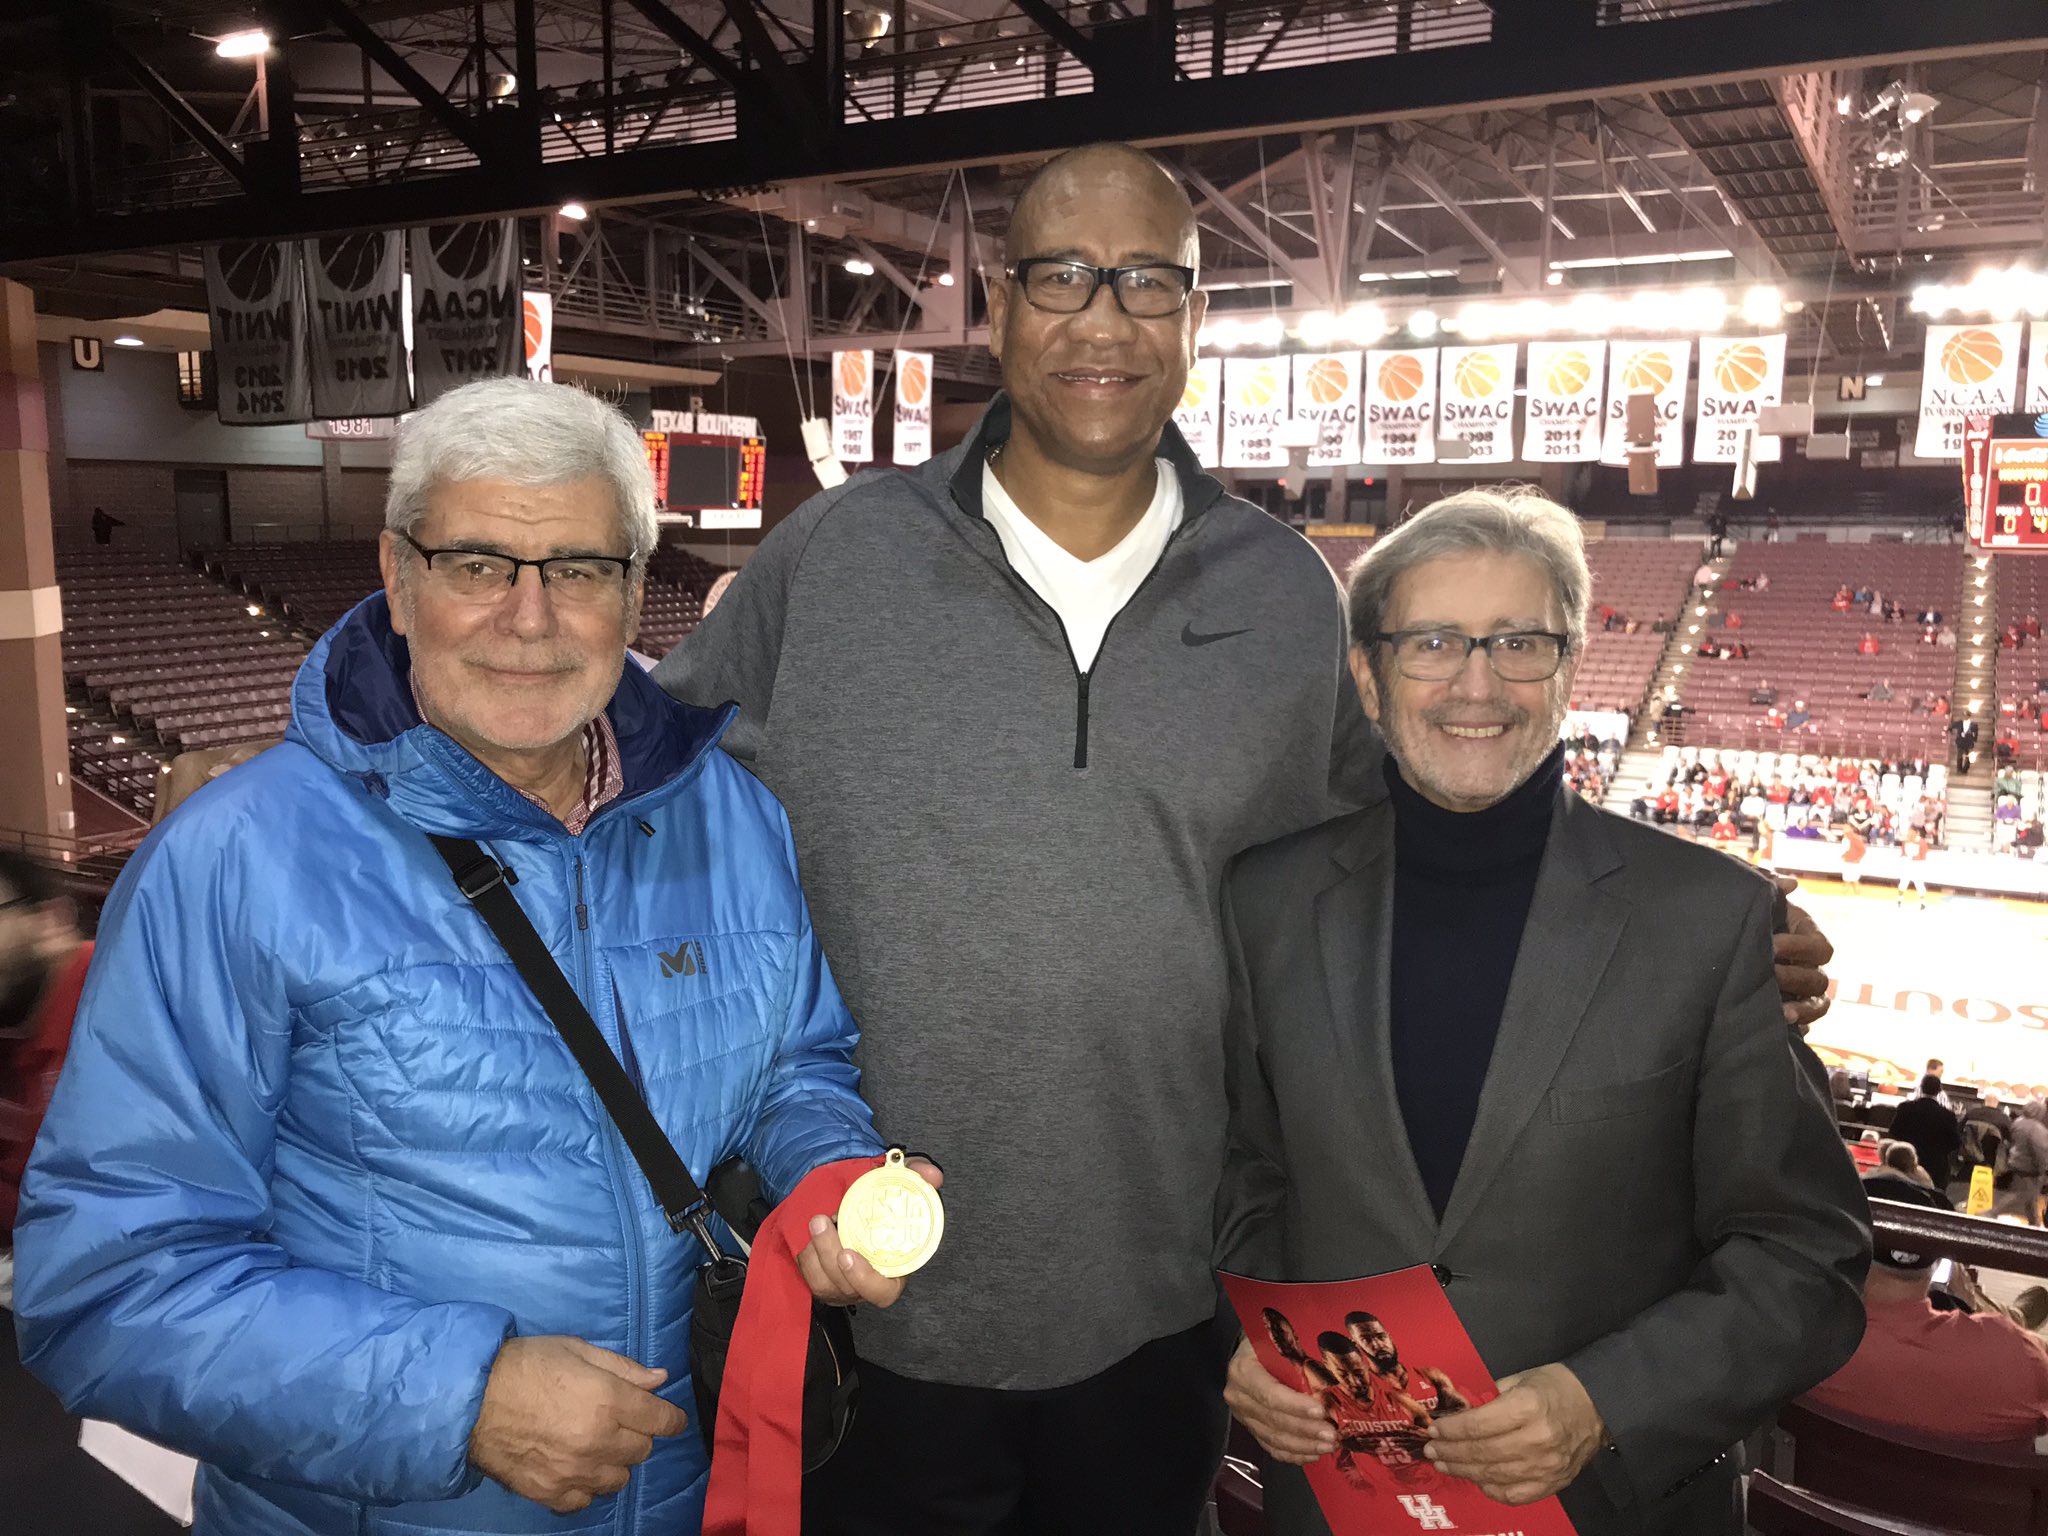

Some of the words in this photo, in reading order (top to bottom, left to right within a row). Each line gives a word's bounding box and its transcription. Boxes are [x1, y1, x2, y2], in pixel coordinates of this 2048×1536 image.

[73, 339, 99, 368] U
[1840, 376, 1865, 399] N
[1931, 387, 2006, 407] NCAA
[835, 395, 870, 418] SWAC
[1369, 402, 1431, 423] SWAC
[1444, 400, 1508, 422] SWAC
[1530, 397, 1597, 418] SWAC
[1611, 400, 1678, 420] SAC
[329, 418, 373, 435] 1981
[652, 410, 693, 434] TEXAS
[697, 413, 757, 438] SOUTHERN
[1178, 410, 1212, 425] AIA
[1228, 408, 1282, 428] SWAC
[1544, 429, 1582, 442] 2011
[1717, 430, 1737, 441] 20
[1942, 423, 1964, 435] 19
[1717, 444, 1736, 455] 20
[1942, 439, 1963, 450] 19
[1828, 978, 2048, 1031] SOUT
[1396, 1494, 1455, 1530] UH
